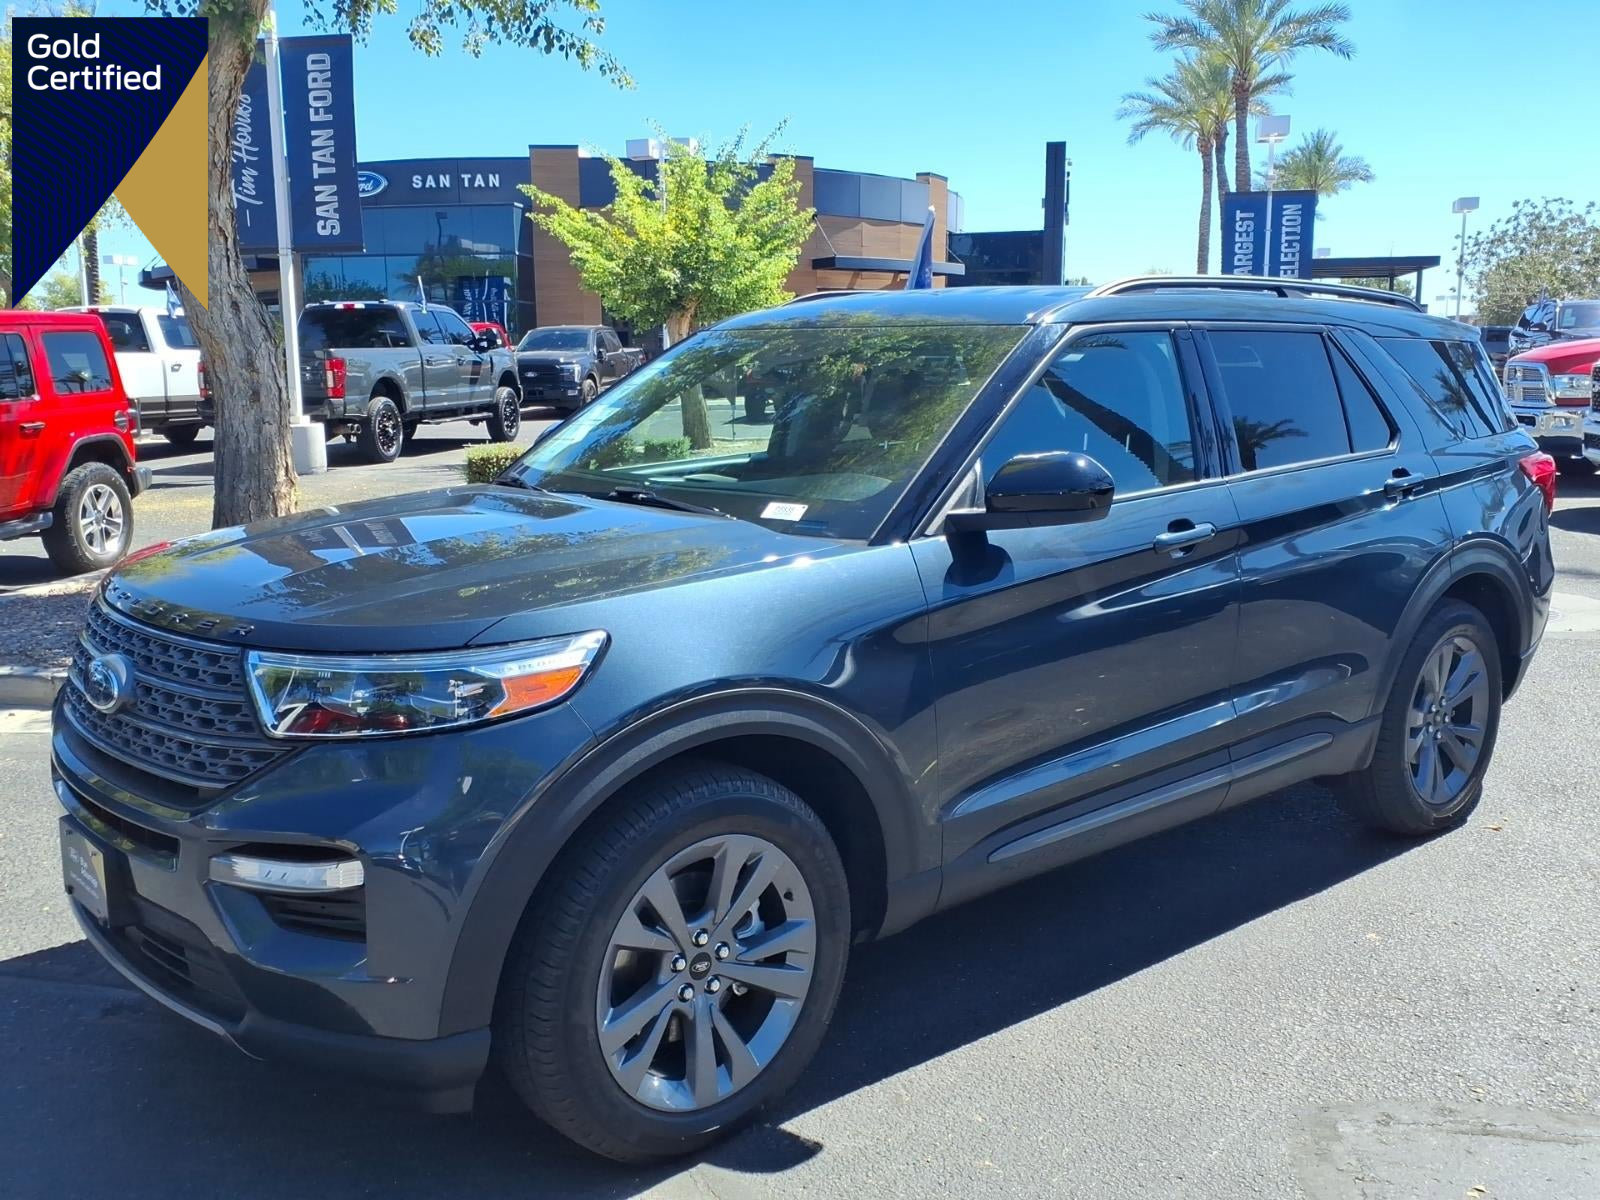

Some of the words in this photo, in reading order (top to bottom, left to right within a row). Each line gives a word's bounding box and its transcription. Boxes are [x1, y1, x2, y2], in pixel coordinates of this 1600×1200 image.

[306, 53, 333, 122] FORD
[310, 128, 336, 179] TAN
[411, 174, 451, 189] SAN
[461, 173, 500, 188] TAN
[314, 185, 340, 236] SAN
[1233, 210, 1255, 276] ARGEST
[1280, 204, 1302, 279] ELECTION
